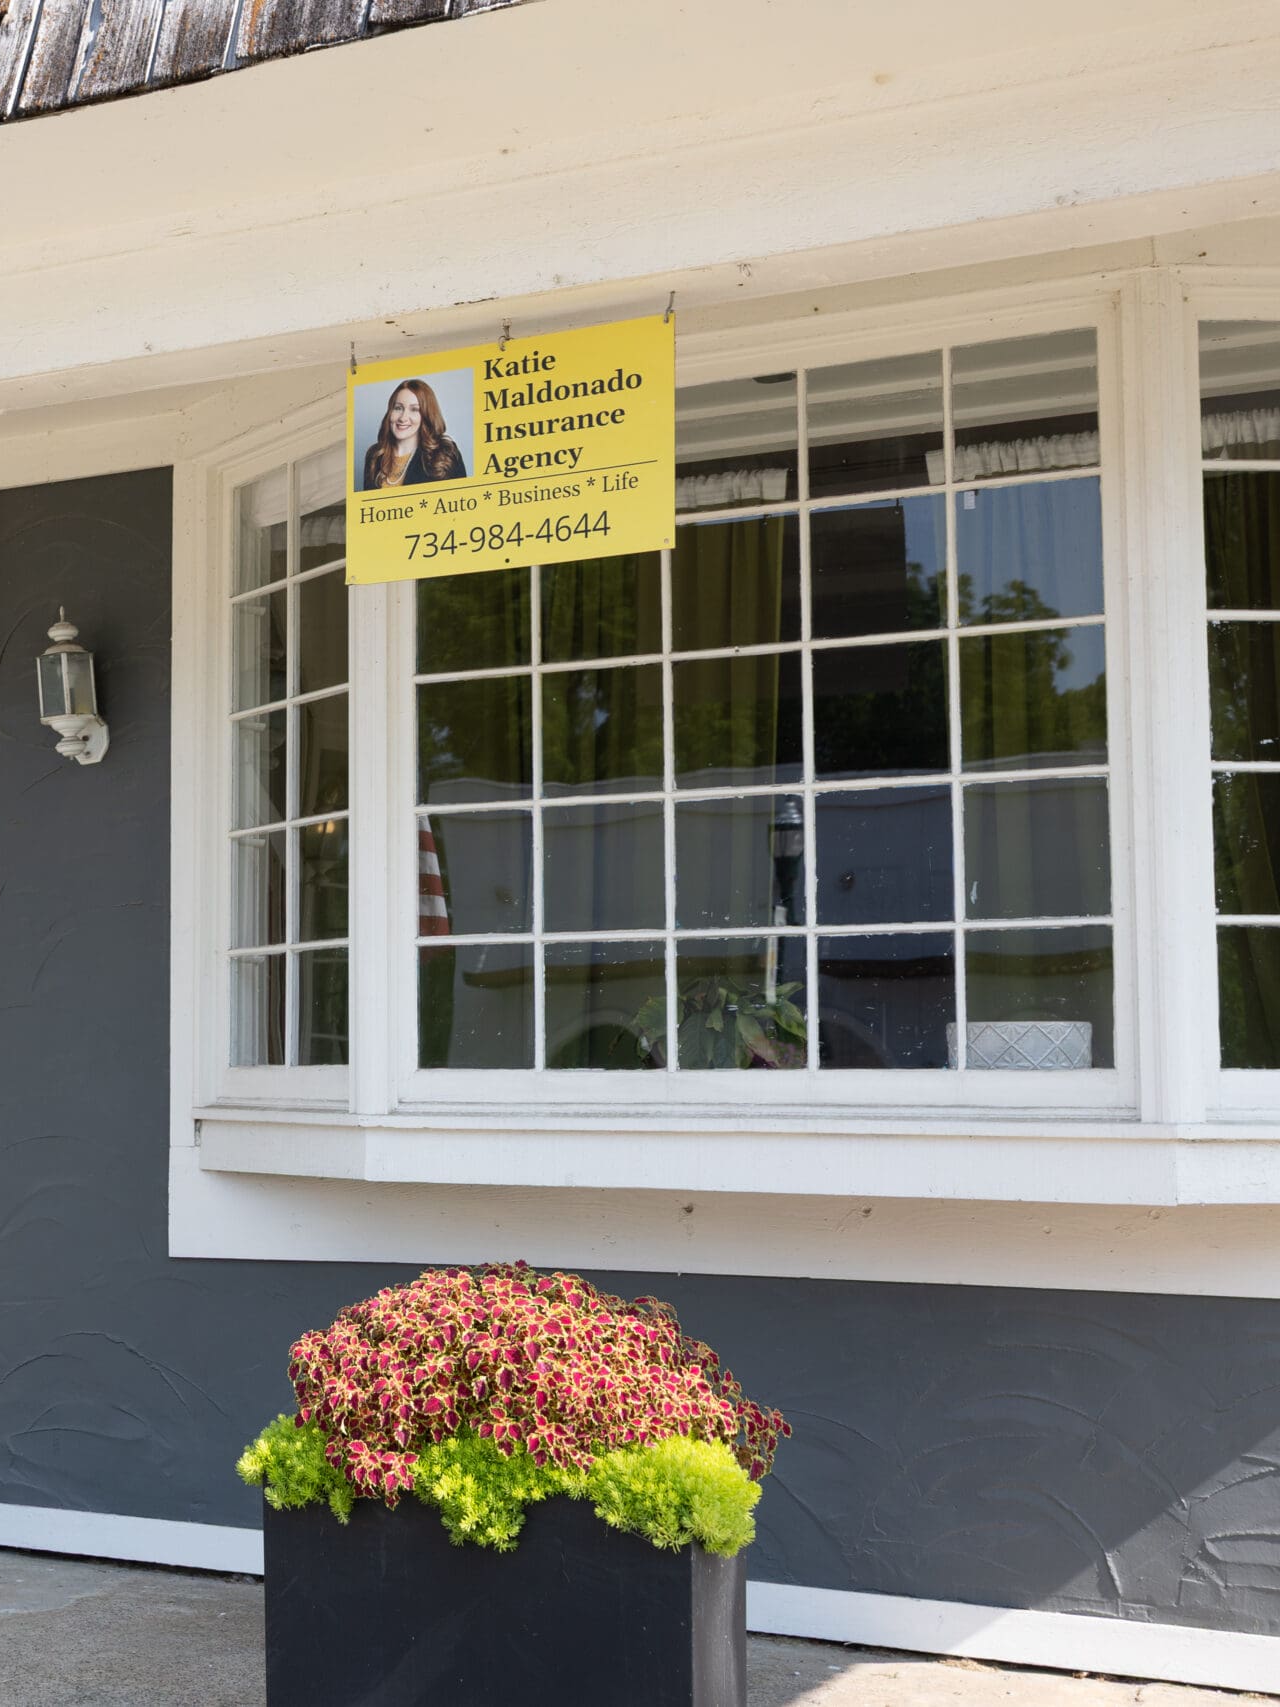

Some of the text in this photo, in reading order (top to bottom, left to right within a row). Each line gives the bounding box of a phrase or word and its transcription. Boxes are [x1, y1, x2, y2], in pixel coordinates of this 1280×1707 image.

[484, 351, 557, 380] Katie
[484, 368, 643, 412] Maldonado
[484, 408, 626, 443] Insurance
[484, 447, 584, 478] Agency
[360, 472, 640, 524] Home Auto Business Life
[405, 510, 611, 560] 734-984-4644
